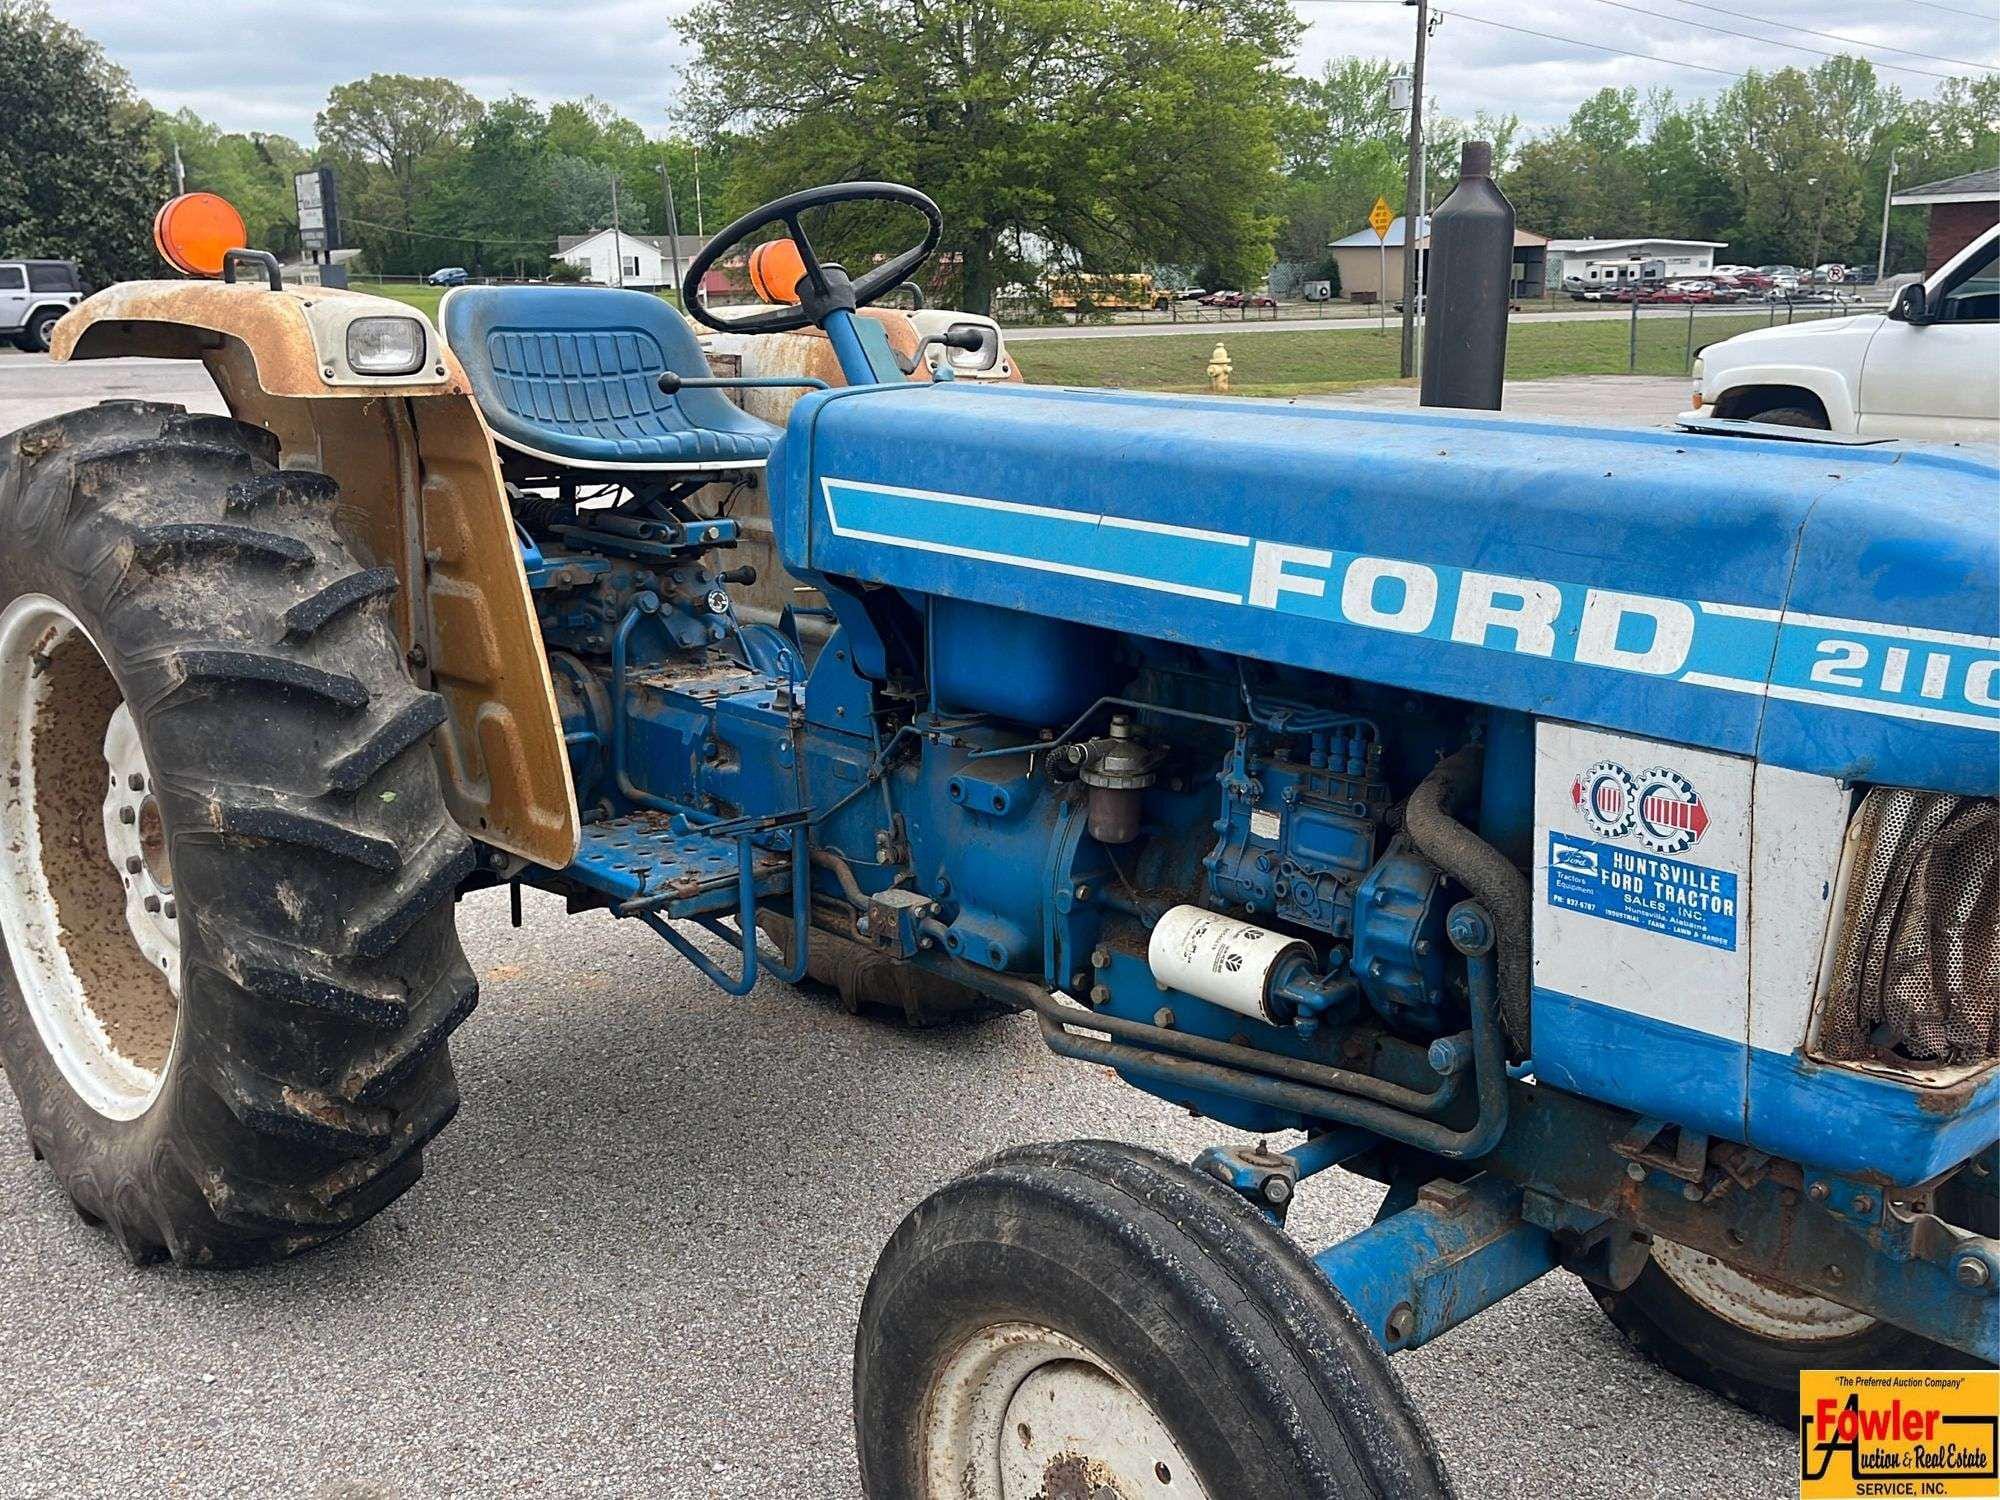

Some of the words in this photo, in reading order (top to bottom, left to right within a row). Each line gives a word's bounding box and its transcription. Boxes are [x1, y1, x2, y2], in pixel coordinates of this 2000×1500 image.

[1249, 540, 1696, 677] FORD
[1809, 639, 2000, 709] 2110
[1556, 871, 1587, 885] Tractors
[1556, 879, 1594, 895] Equipment
[1613, 851, 1721, 893] HUNTSVILLE
[1601, 868, 1643, 894] FORD
[1654, 881, 1734, 917] TRACTOR
[1605, 908, 1640, 923] INDUSTRIAL
[1673, 924, 1692, 936] LAWN
[1678, 907, 1706, 922] INC.
